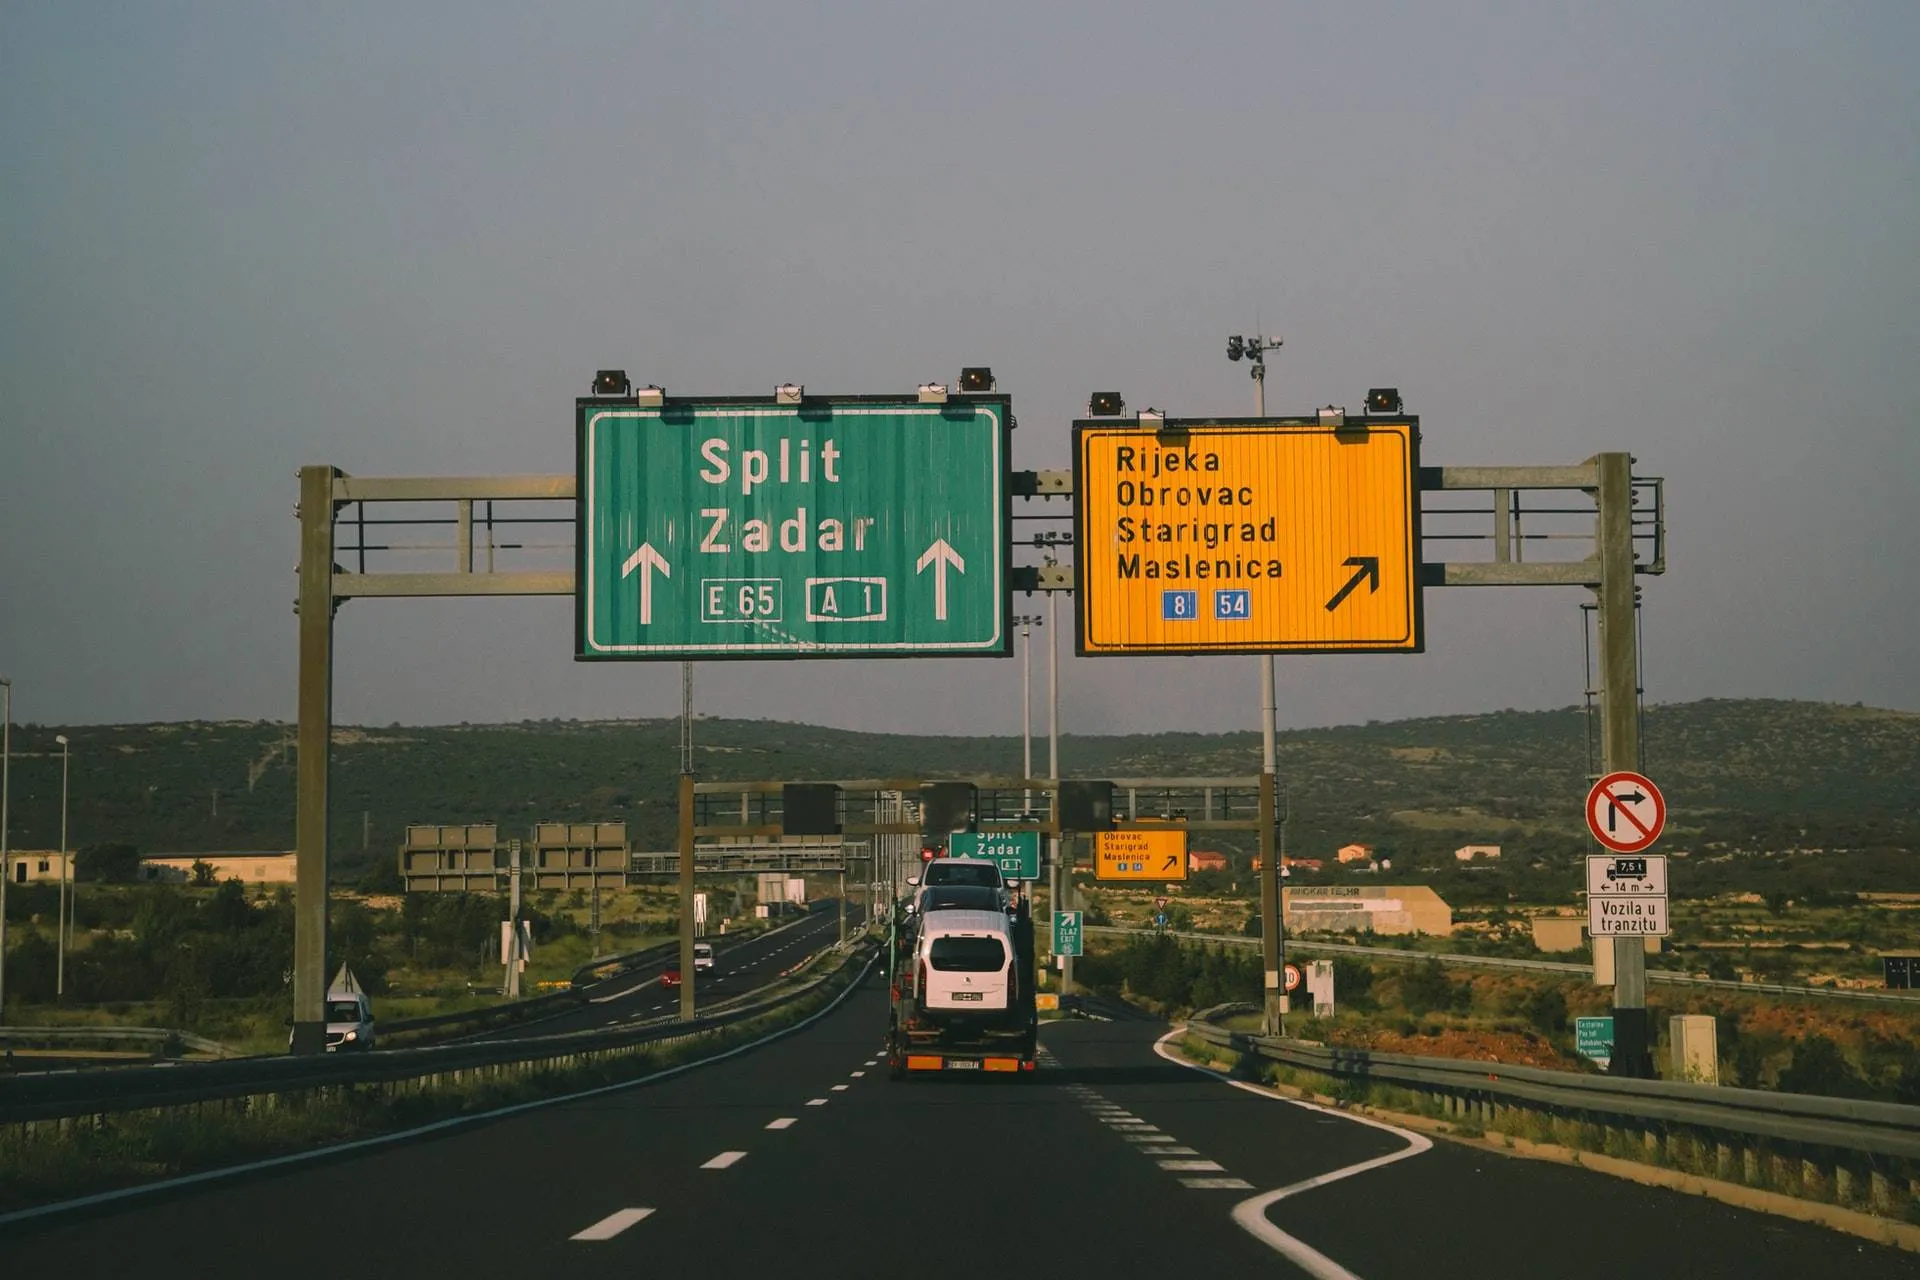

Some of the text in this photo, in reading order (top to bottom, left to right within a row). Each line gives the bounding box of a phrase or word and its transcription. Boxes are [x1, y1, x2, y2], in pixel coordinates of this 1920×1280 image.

[700, 438, 841, 495] Split
[1117, 446, 1220, 478] Rijeka
[1117, 481, 1253, 506] Obrovac
[700, 507, 875, 552] Zadar
[1117, 517, 1276, 549] Starigrad
[1117, 554, 1283, 579] Maslenica
[709, 585, 774, 615] E 65
[822, 585, 872, 613] A 1
[1174, 595, 1185, 616] 8
[1220, 594, 1245, 615] 54
[1104, 832, 1142, 840] Obrovac
[977, 843, 1021, 855] Zadar
[1104, 843, 1148, 851] Starigrad
[1621, 863, 1635, 872] 7,5
[1616, 883, 1639, 892] 14 m
[1601, 901, 1655, 915] Vozila u
[1602, 917, 1656, 931] tranzitu
